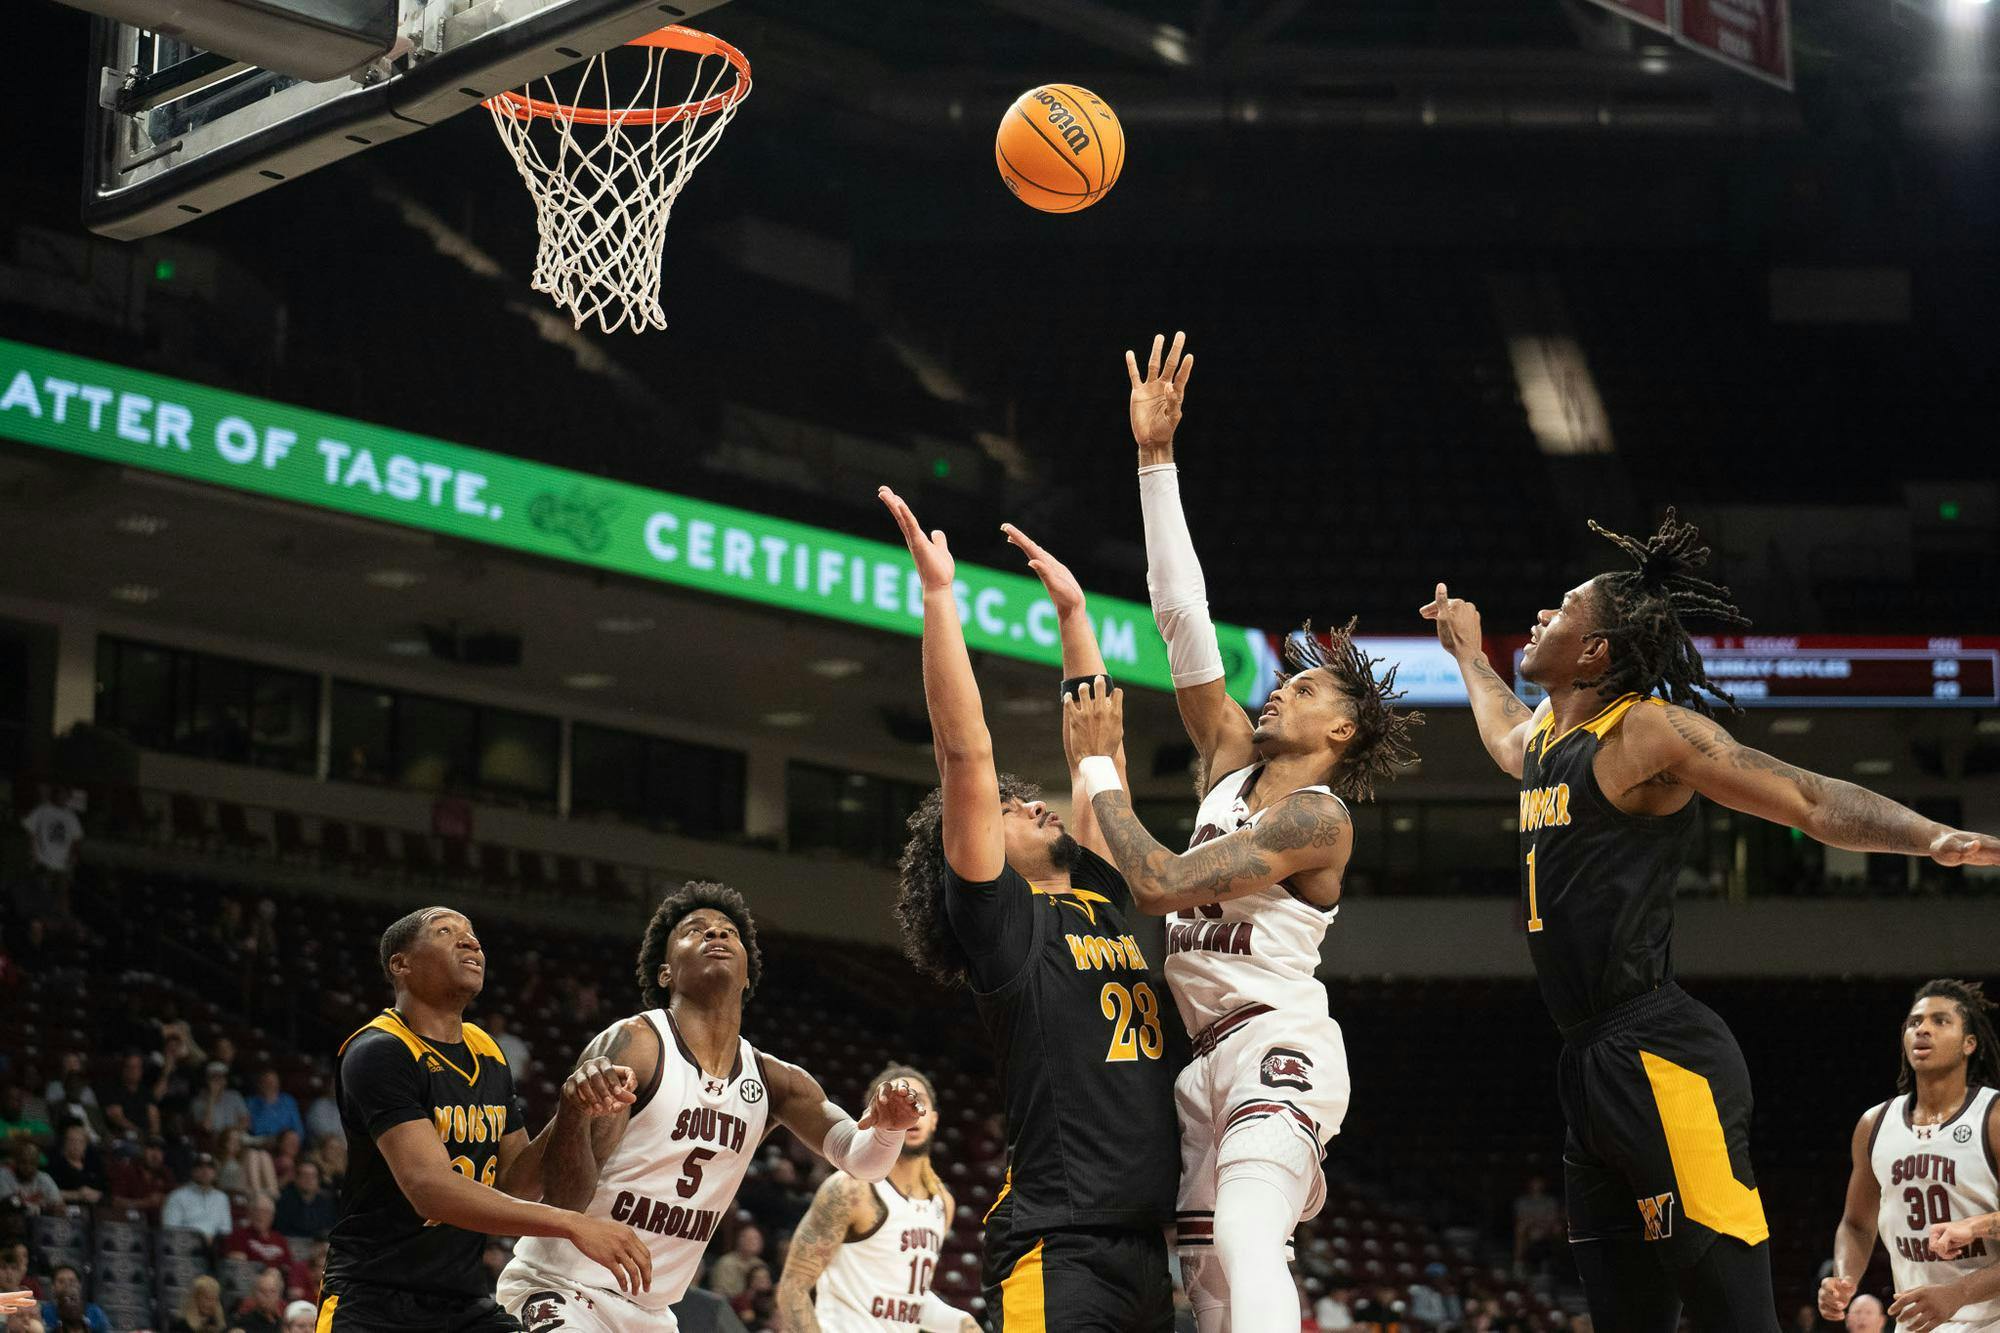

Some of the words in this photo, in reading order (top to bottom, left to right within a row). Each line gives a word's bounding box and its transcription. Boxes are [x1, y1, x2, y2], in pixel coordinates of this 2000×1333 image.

[1032, 89, 1090, 156] Wilson
[213, 415, 298, 470] OF
[315, 437, 504, 521] TASTE.
[1526, 843, 1543, 932] 1
[1101, 982, 1163, 1062] 23
[742, 1080, 763, 1102] SEC
[670, 1107, 747, 1154] SOUTH
[676, 1146, 718, 1199] 5
[1891, 1153, 1956, 1186] SOUTH
[610, 1190, 720, 1242] CAROLIN
[1904, 1184, 1951, 1231] 30
